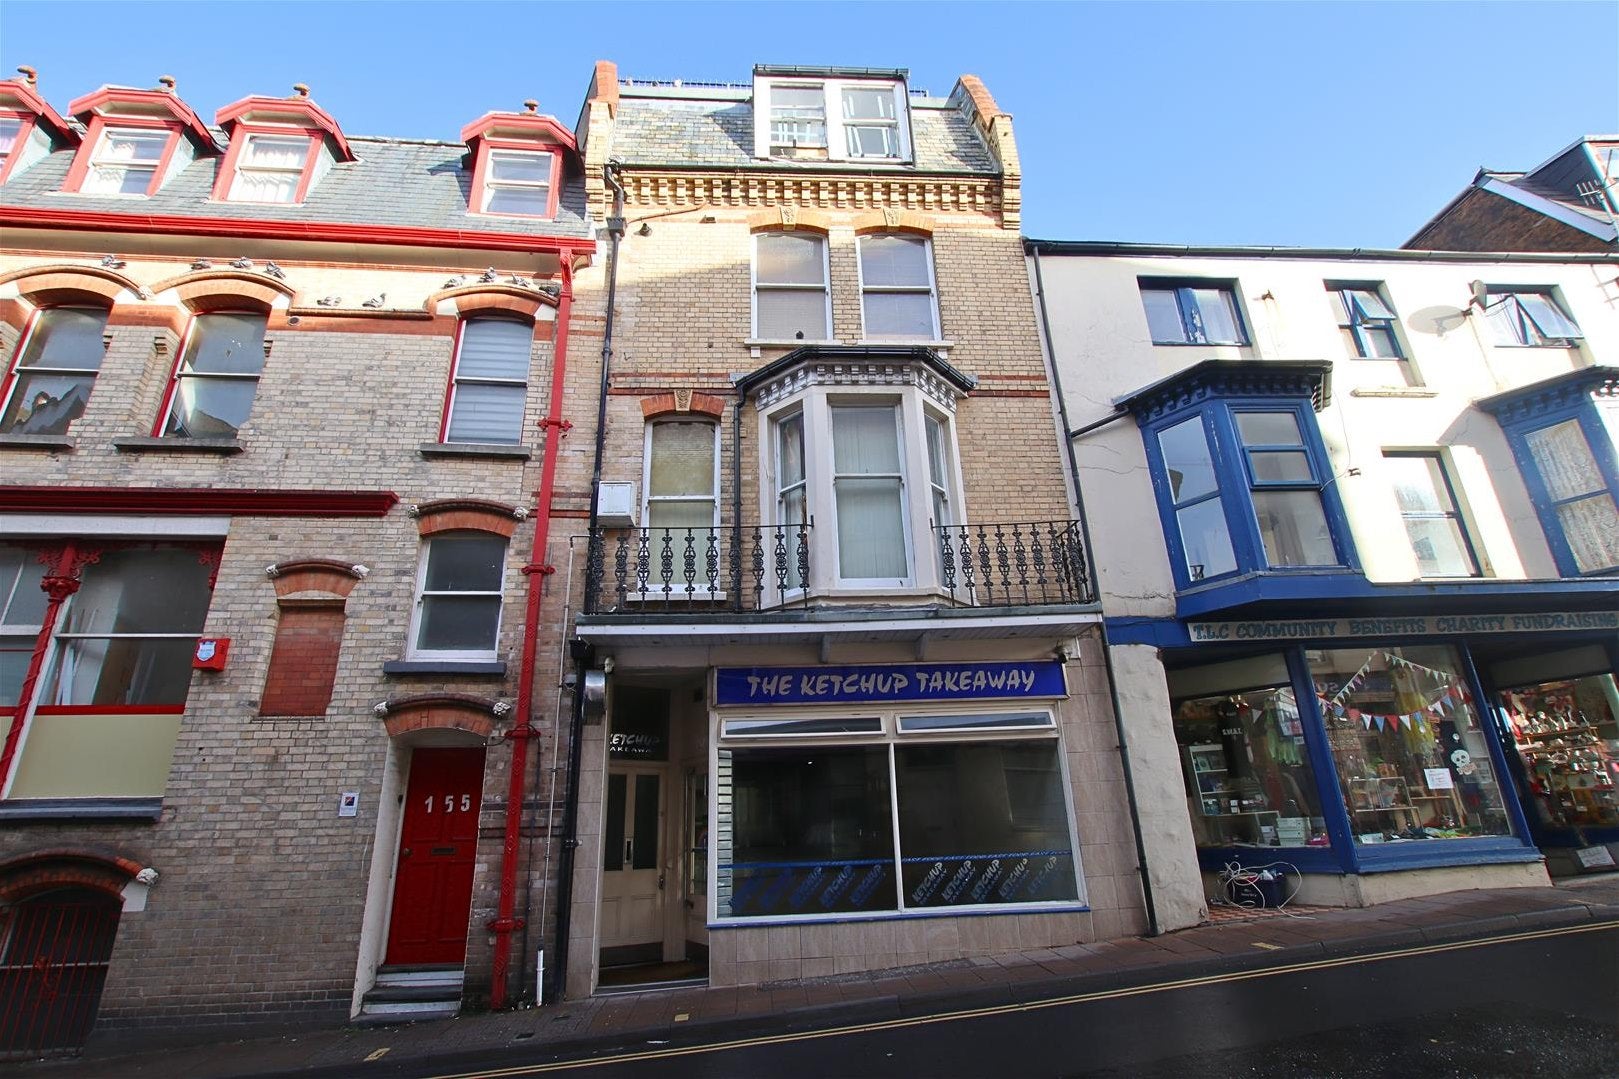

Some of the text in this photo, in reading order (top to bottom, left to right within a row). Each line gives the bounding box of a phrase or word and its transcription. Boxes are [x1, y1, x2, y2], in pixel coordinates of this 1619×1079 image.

[1237, 621, 1337, 639] COMMUNITY
[1350, 618, 1427, 636] BENEFITS
[1436, 616, 1505, 633] CHARITY
[1511, 612, 1617, 630] FUNDRAISING
[747, 669, 1036, 697] THE KETCHUP TAKEAWAY
